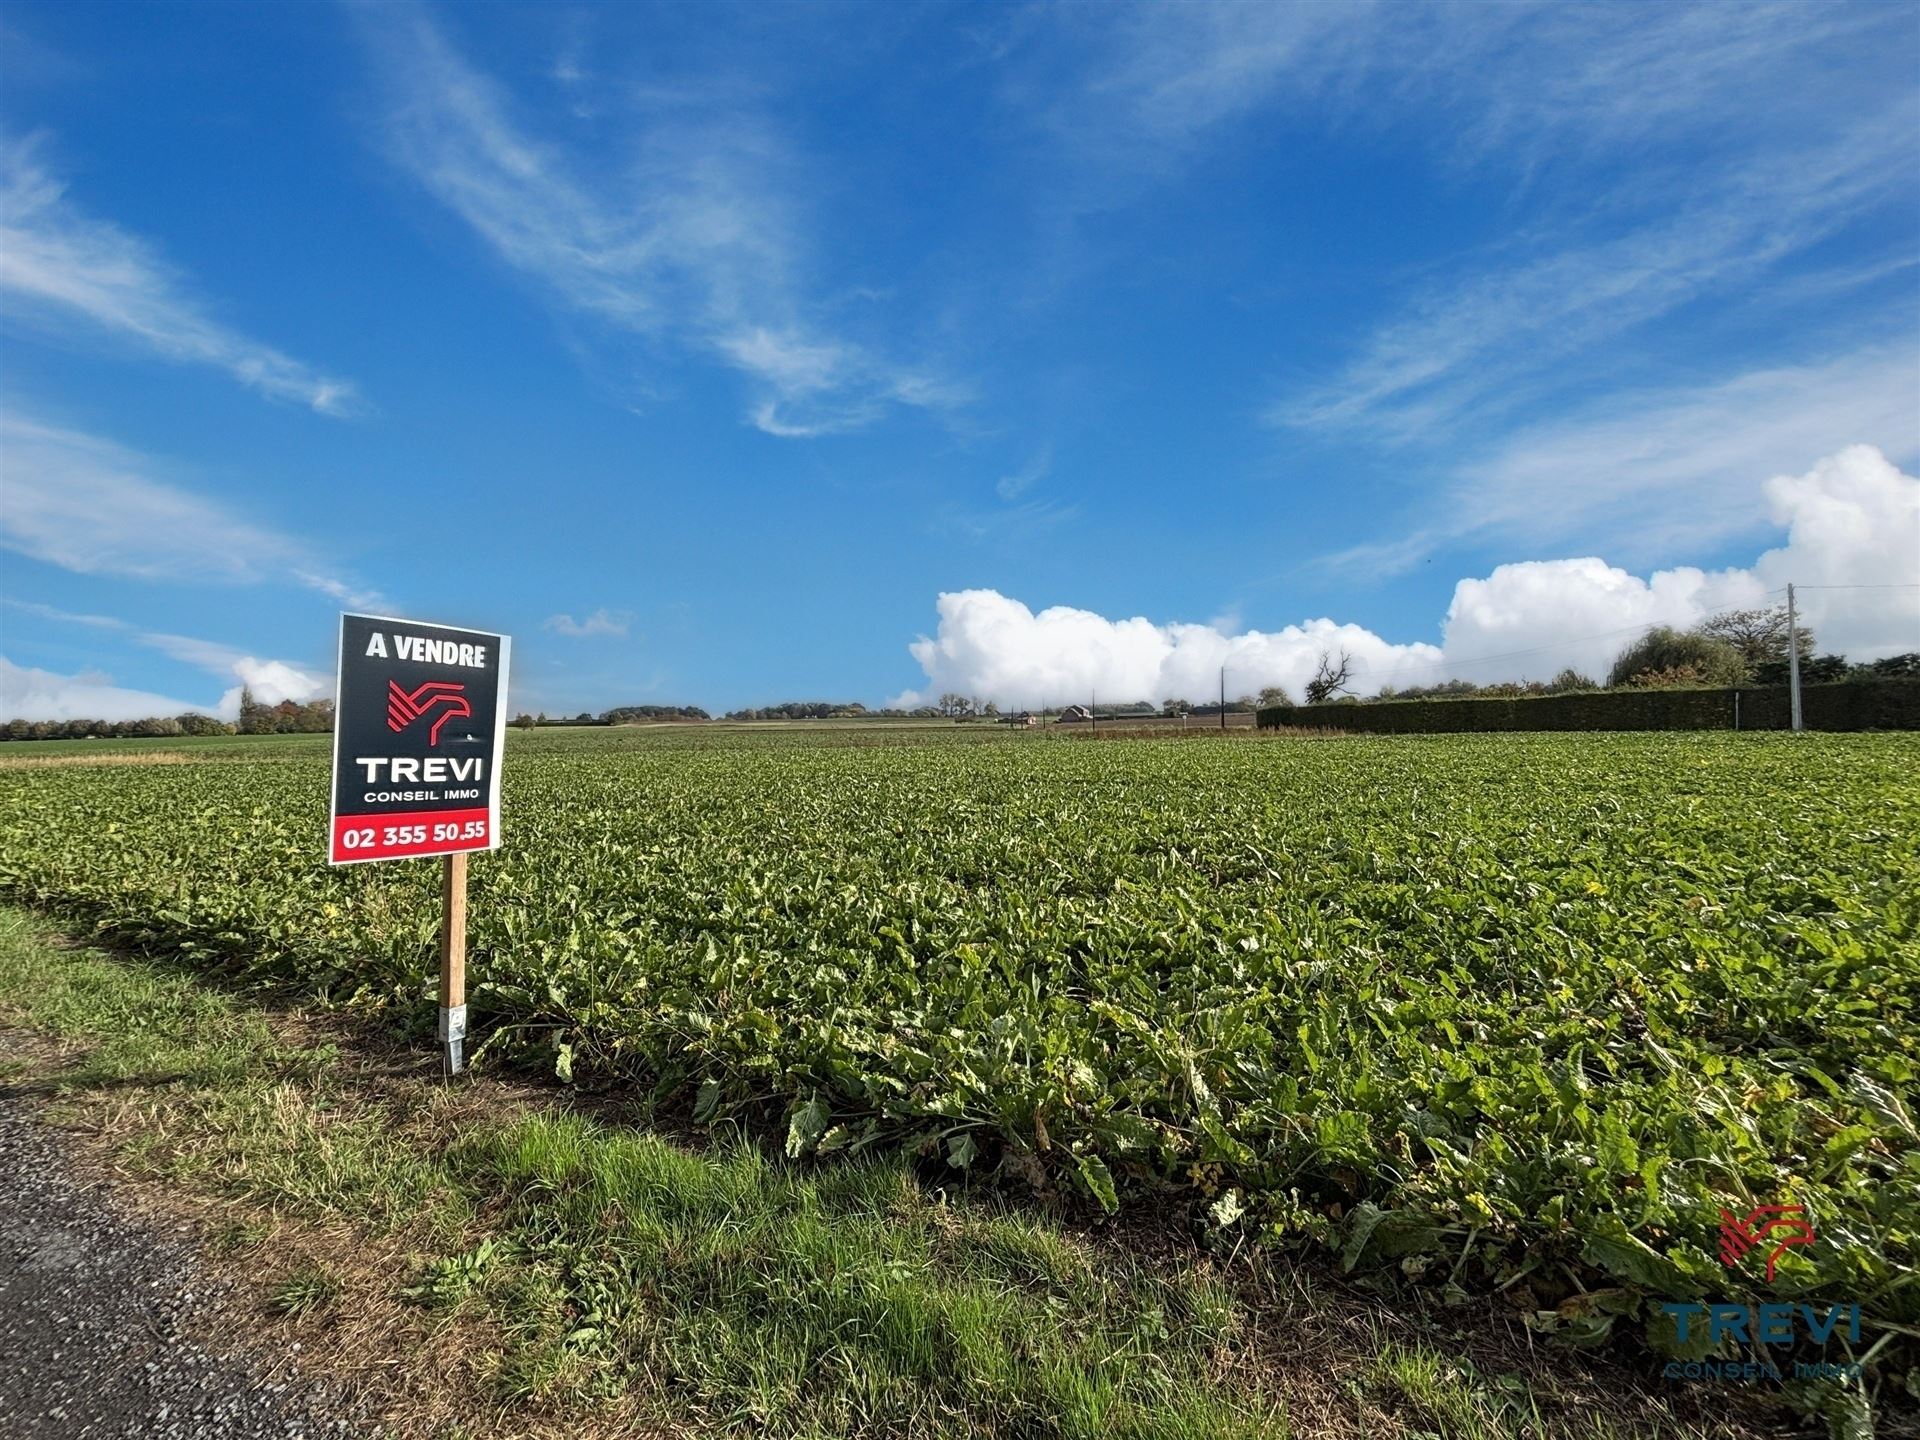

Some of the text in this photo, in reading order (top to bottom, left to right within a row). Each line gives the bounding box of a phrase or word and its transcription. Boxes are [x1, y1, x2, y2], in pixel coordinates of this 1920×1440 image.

[365, 632, 486, 668] A VENDRE
[356, 757, 482, 784] TREVI
[363, 789, 479, 803] CONSEIL IMMO
[343, 821, 486, 849] 02 355 50.55
